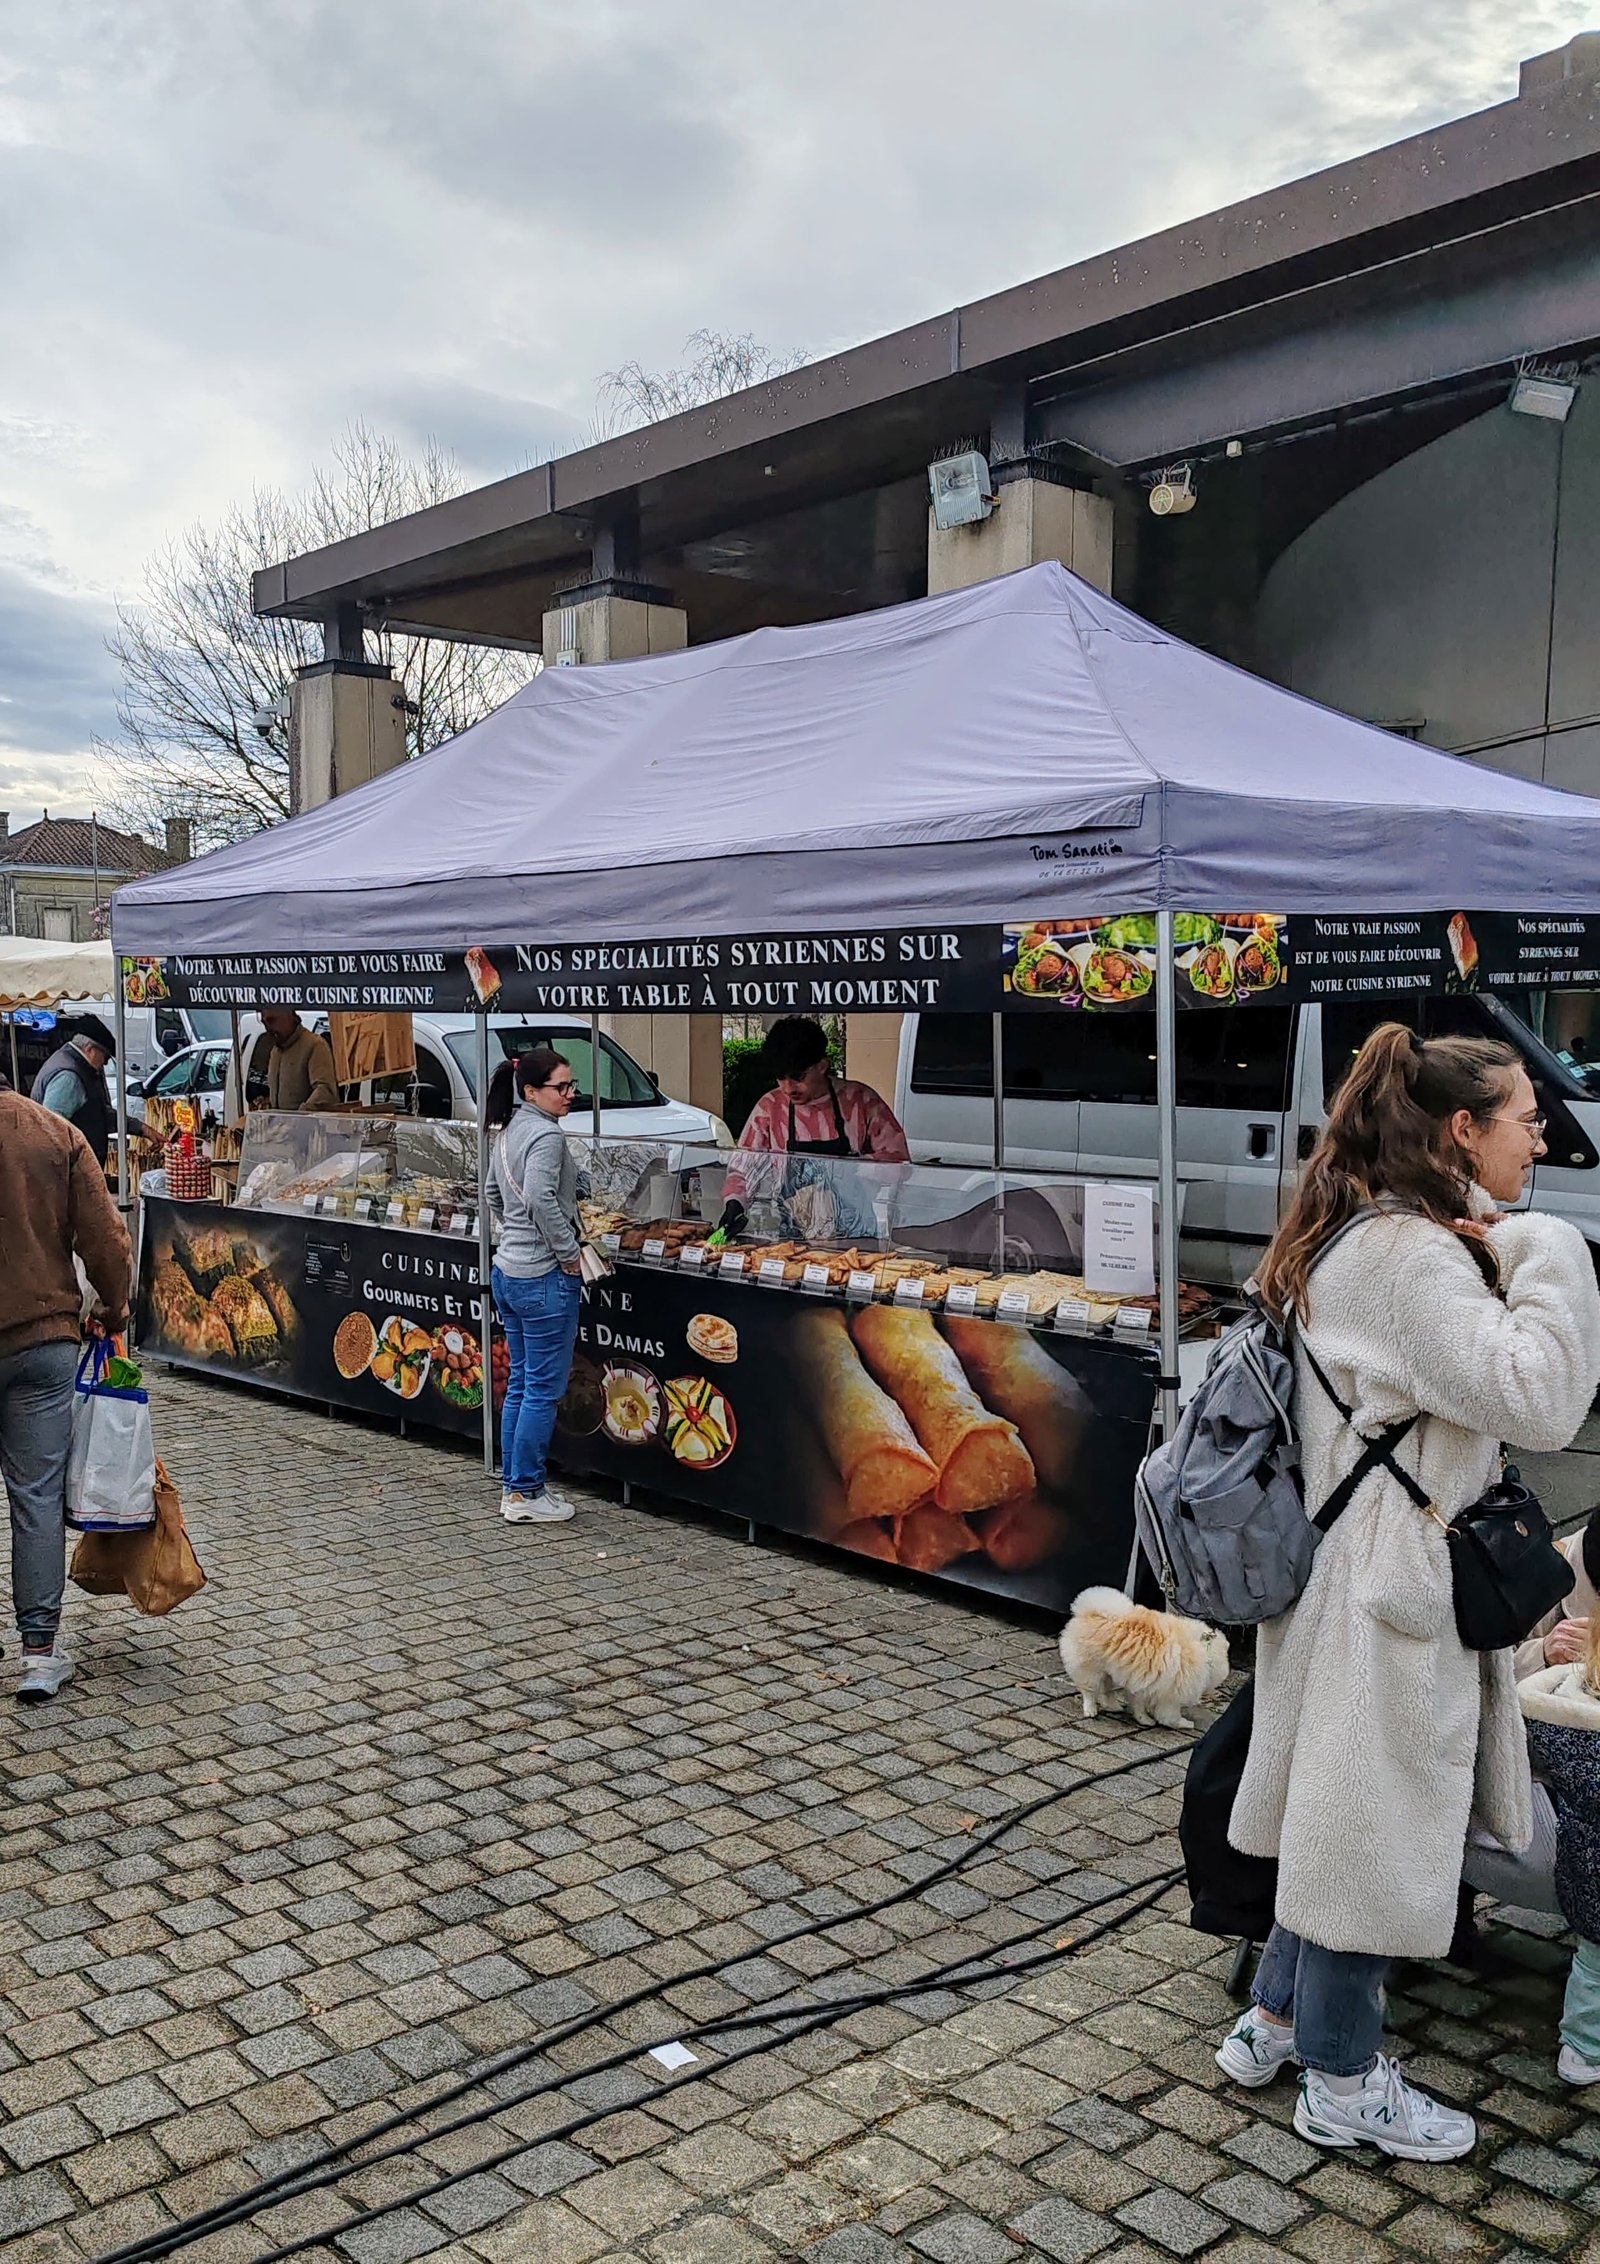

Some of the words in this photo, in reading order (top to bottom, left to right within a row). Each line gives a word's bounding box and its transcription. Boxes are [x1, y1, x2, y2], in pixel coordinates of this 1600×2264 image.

[1029, 845, 1058, 861] Tom
[1061, 842, 1107, 859] Sanati
[1315, 919, 1349, 935] NOTRE
[1353, 923, 1380, 934] VRAIE
[1384, 922, 1420, 934] PASSION
[1518, 919, 1536, 933] NOS
[1538, 918, 1585, 933] SPÉCIALITÉS
[515, 944, 562, 971] NOS
[571, 937, 719, 970] SPÉCIALITÉS
[732, 937, 885, 965] SYRIENNES
[900, 935, 961, 960] SUR
[1296, 952, 1313, 964] EST
[1316, 952, 1328, 963] DE
[1332, 951, 1357, 963] VOUS
[1360, 950, 1385, 962] FAIRE
[1389, 945, 1441, 961] DÉCOUVRIR
[1564, 947, 1578, 957] SUR
[174, 954, 215, 975] NOTRE
[217, 959, 252, 974] VRAIE
[256, 958, 307, 974] PASSION
[311, 957, 334, 973] EST
[338, 956, 357, 972] DE
[361, 955, 398, 972] VOUS
[402, 954, 445, 971] FAIRE
[189, 981, 257, 1003] DÉCOUVRIR
[260, 987, 302, 1003] NOTRE
[306, 987, 358, 1004] CUISINE
[363, 987, 433, 1004] SYRIENNE
[537, 986, 609, 1006] VOTRE
[618, 985, 690, 1005] TABLE
[702, 974, 716, 1005] À
[728, 982, 798, 1005] TOUT
[810, 980, 939, 1004] MOMENT
[1311, 979, 1343, 992] NOTRE
[1347, 977, 1383, 990] CUISINE
[1386, 975, 1431, 988] SYRIENNE
[382, 1253, 478, 1284] CUISINE
[364, 1280, 438, 1311] GOURMETS
[445, 1295, 462, 1316] ET
[597, 1325, 664, 1357] DAMAS
